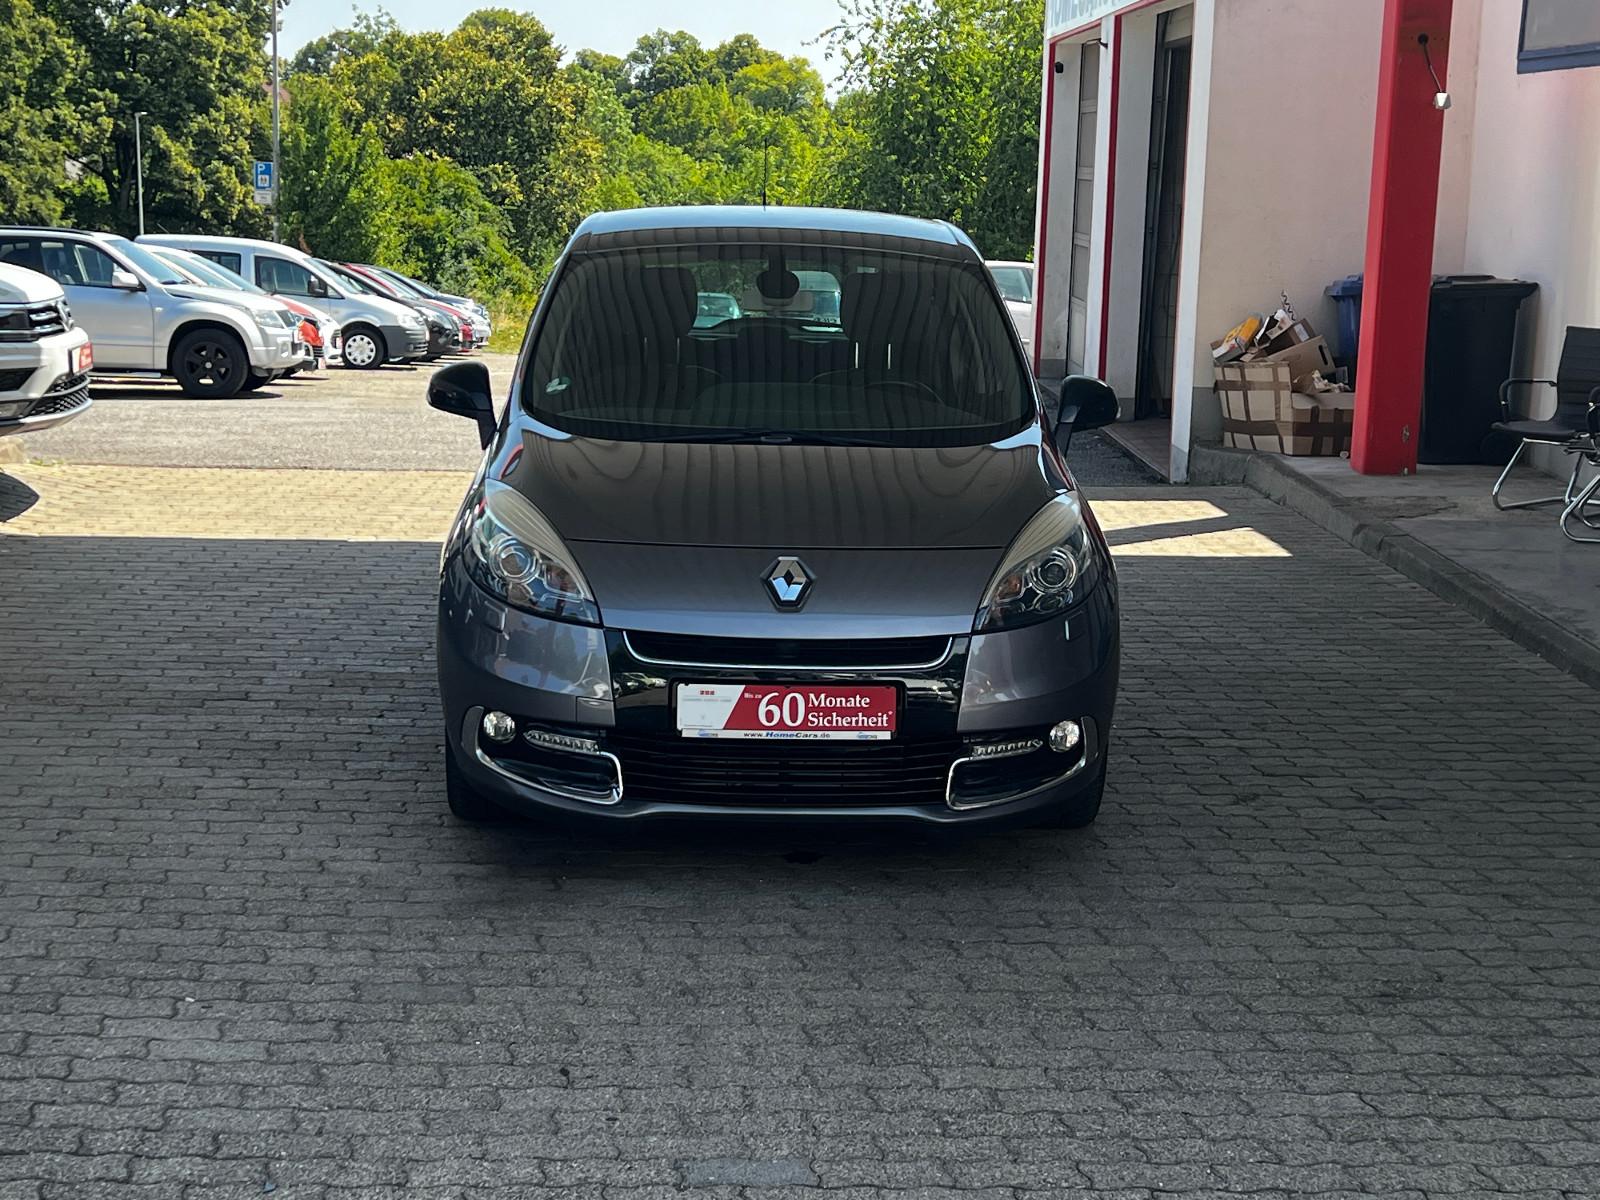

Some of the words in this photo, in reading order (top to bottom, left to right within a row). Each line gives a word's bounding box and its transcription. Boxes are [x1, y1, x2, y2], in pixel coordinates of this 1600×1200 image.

[257, 163, 266, 174] P
[807, 692, 871, 708] Monate
[757, 691, 806, 727] 60
[743, 731, 831, 739] www.HomeCars.de
